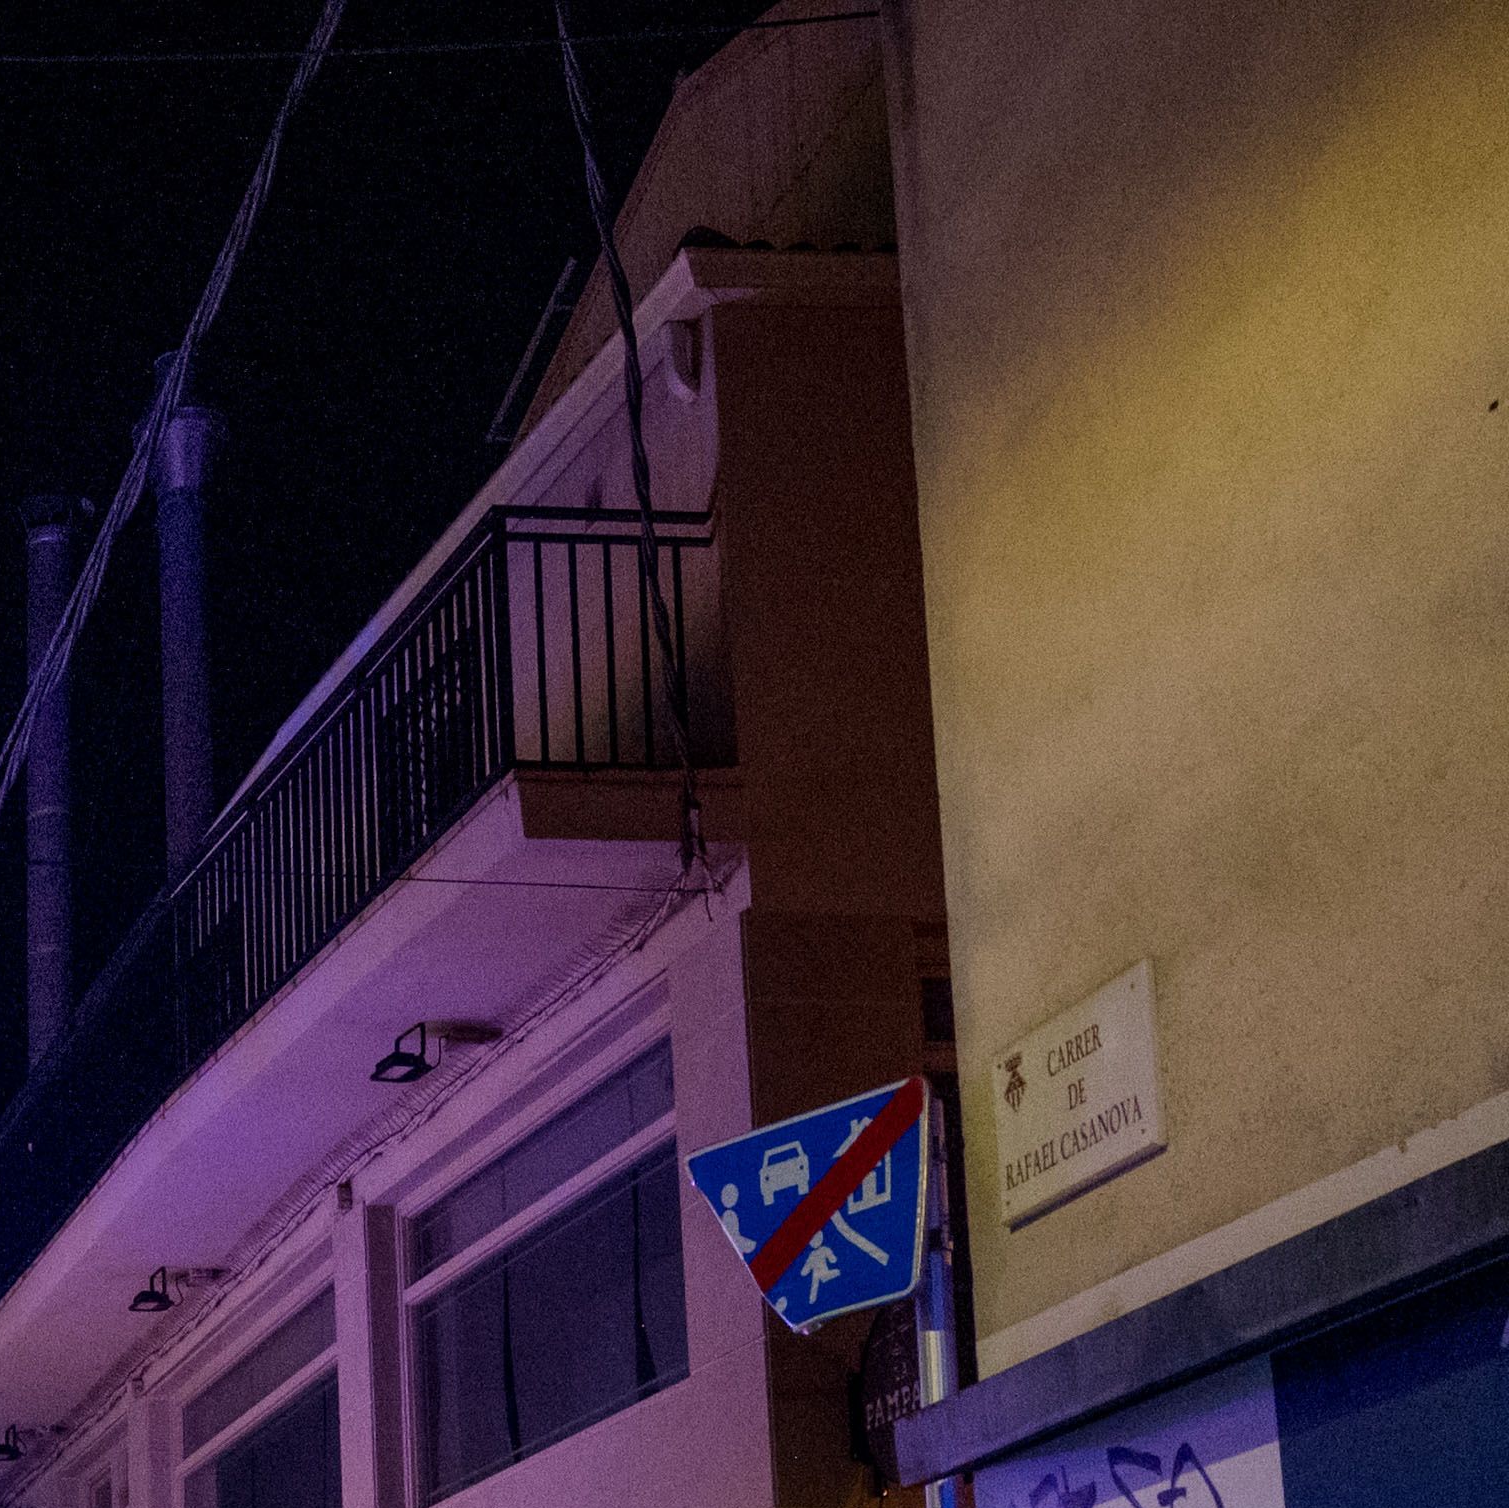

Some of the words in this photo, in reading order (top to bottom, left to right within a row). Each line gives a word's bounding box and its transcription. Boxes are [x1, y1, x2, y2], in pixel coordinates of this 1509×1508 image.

[1046, 1023, 1103, 1077] CARRER
[1067, 1077, 1086, 1110] DE
[1005, 1139, 1059, 1190] RAFAEL
[1060, 1095, 1143, 1160] CASANOVA
